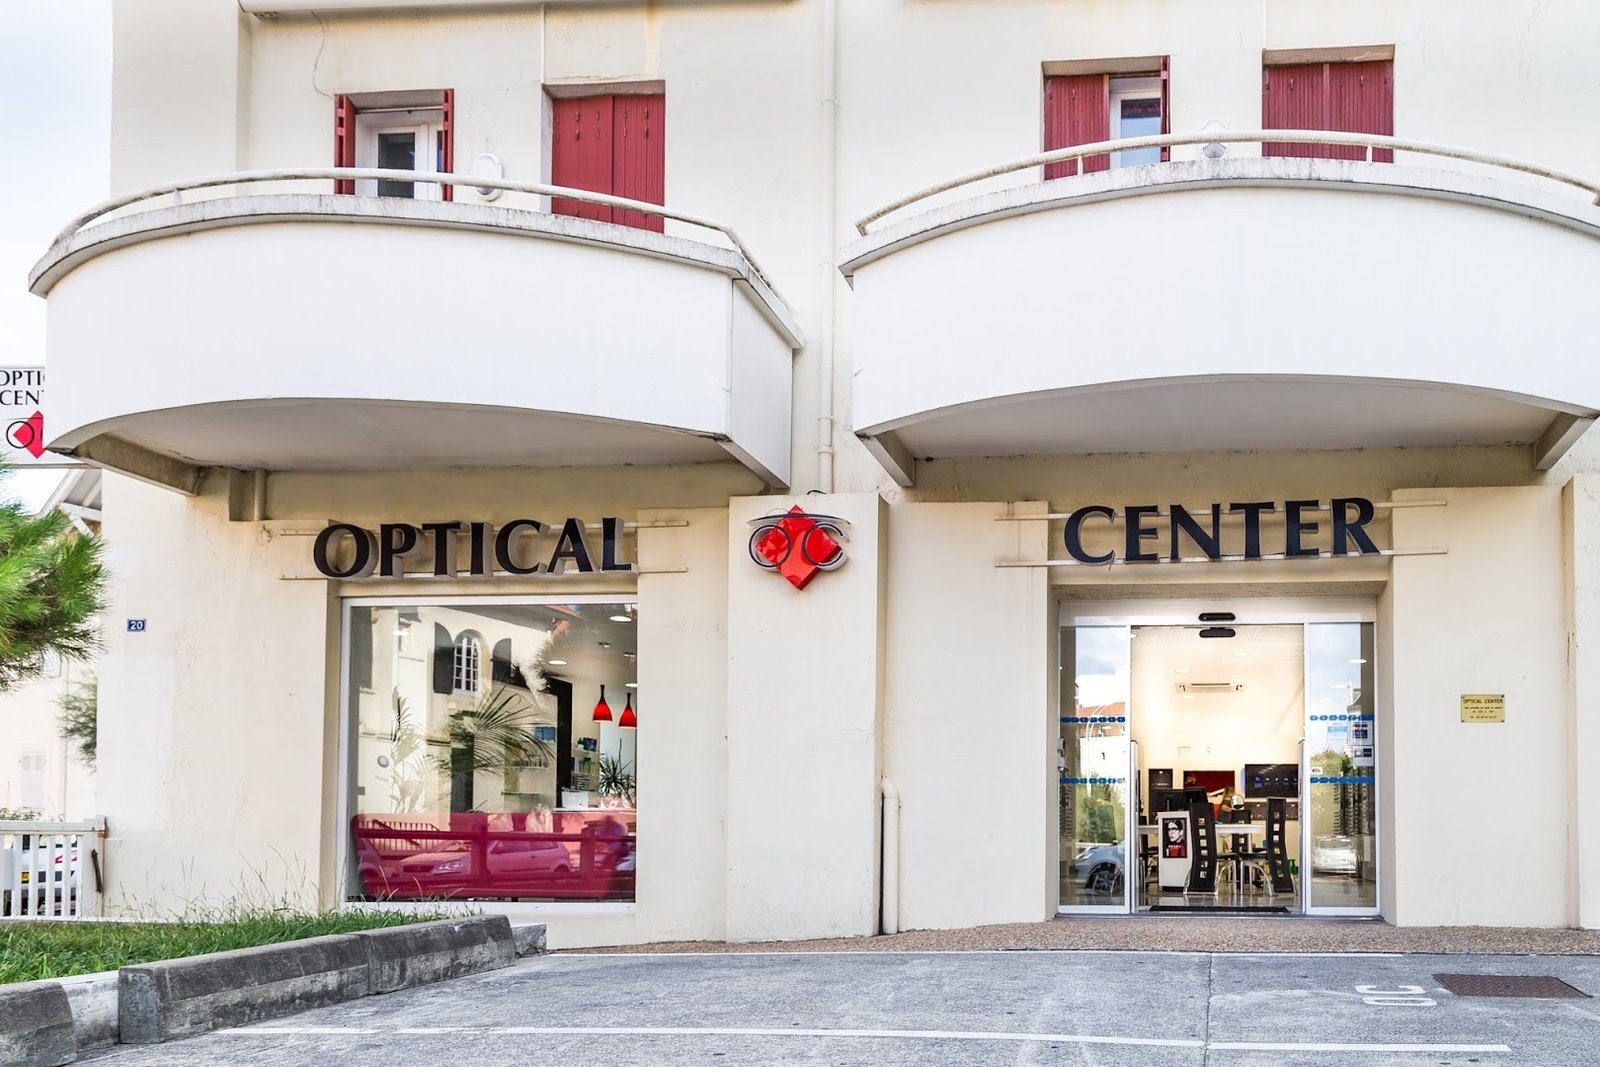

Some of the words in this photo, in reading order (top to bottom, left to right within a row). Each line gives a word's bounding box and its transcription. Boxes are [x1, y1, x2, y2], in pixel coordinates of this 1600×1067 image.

[0, 369, 46, 386] OPTI
[0, 389, 45, 406] CEN
[313, 518, 636, 577] OPTICAL
[1063, 496, 1381, 565] CENTER
[130, 620, 143, 630] 20
